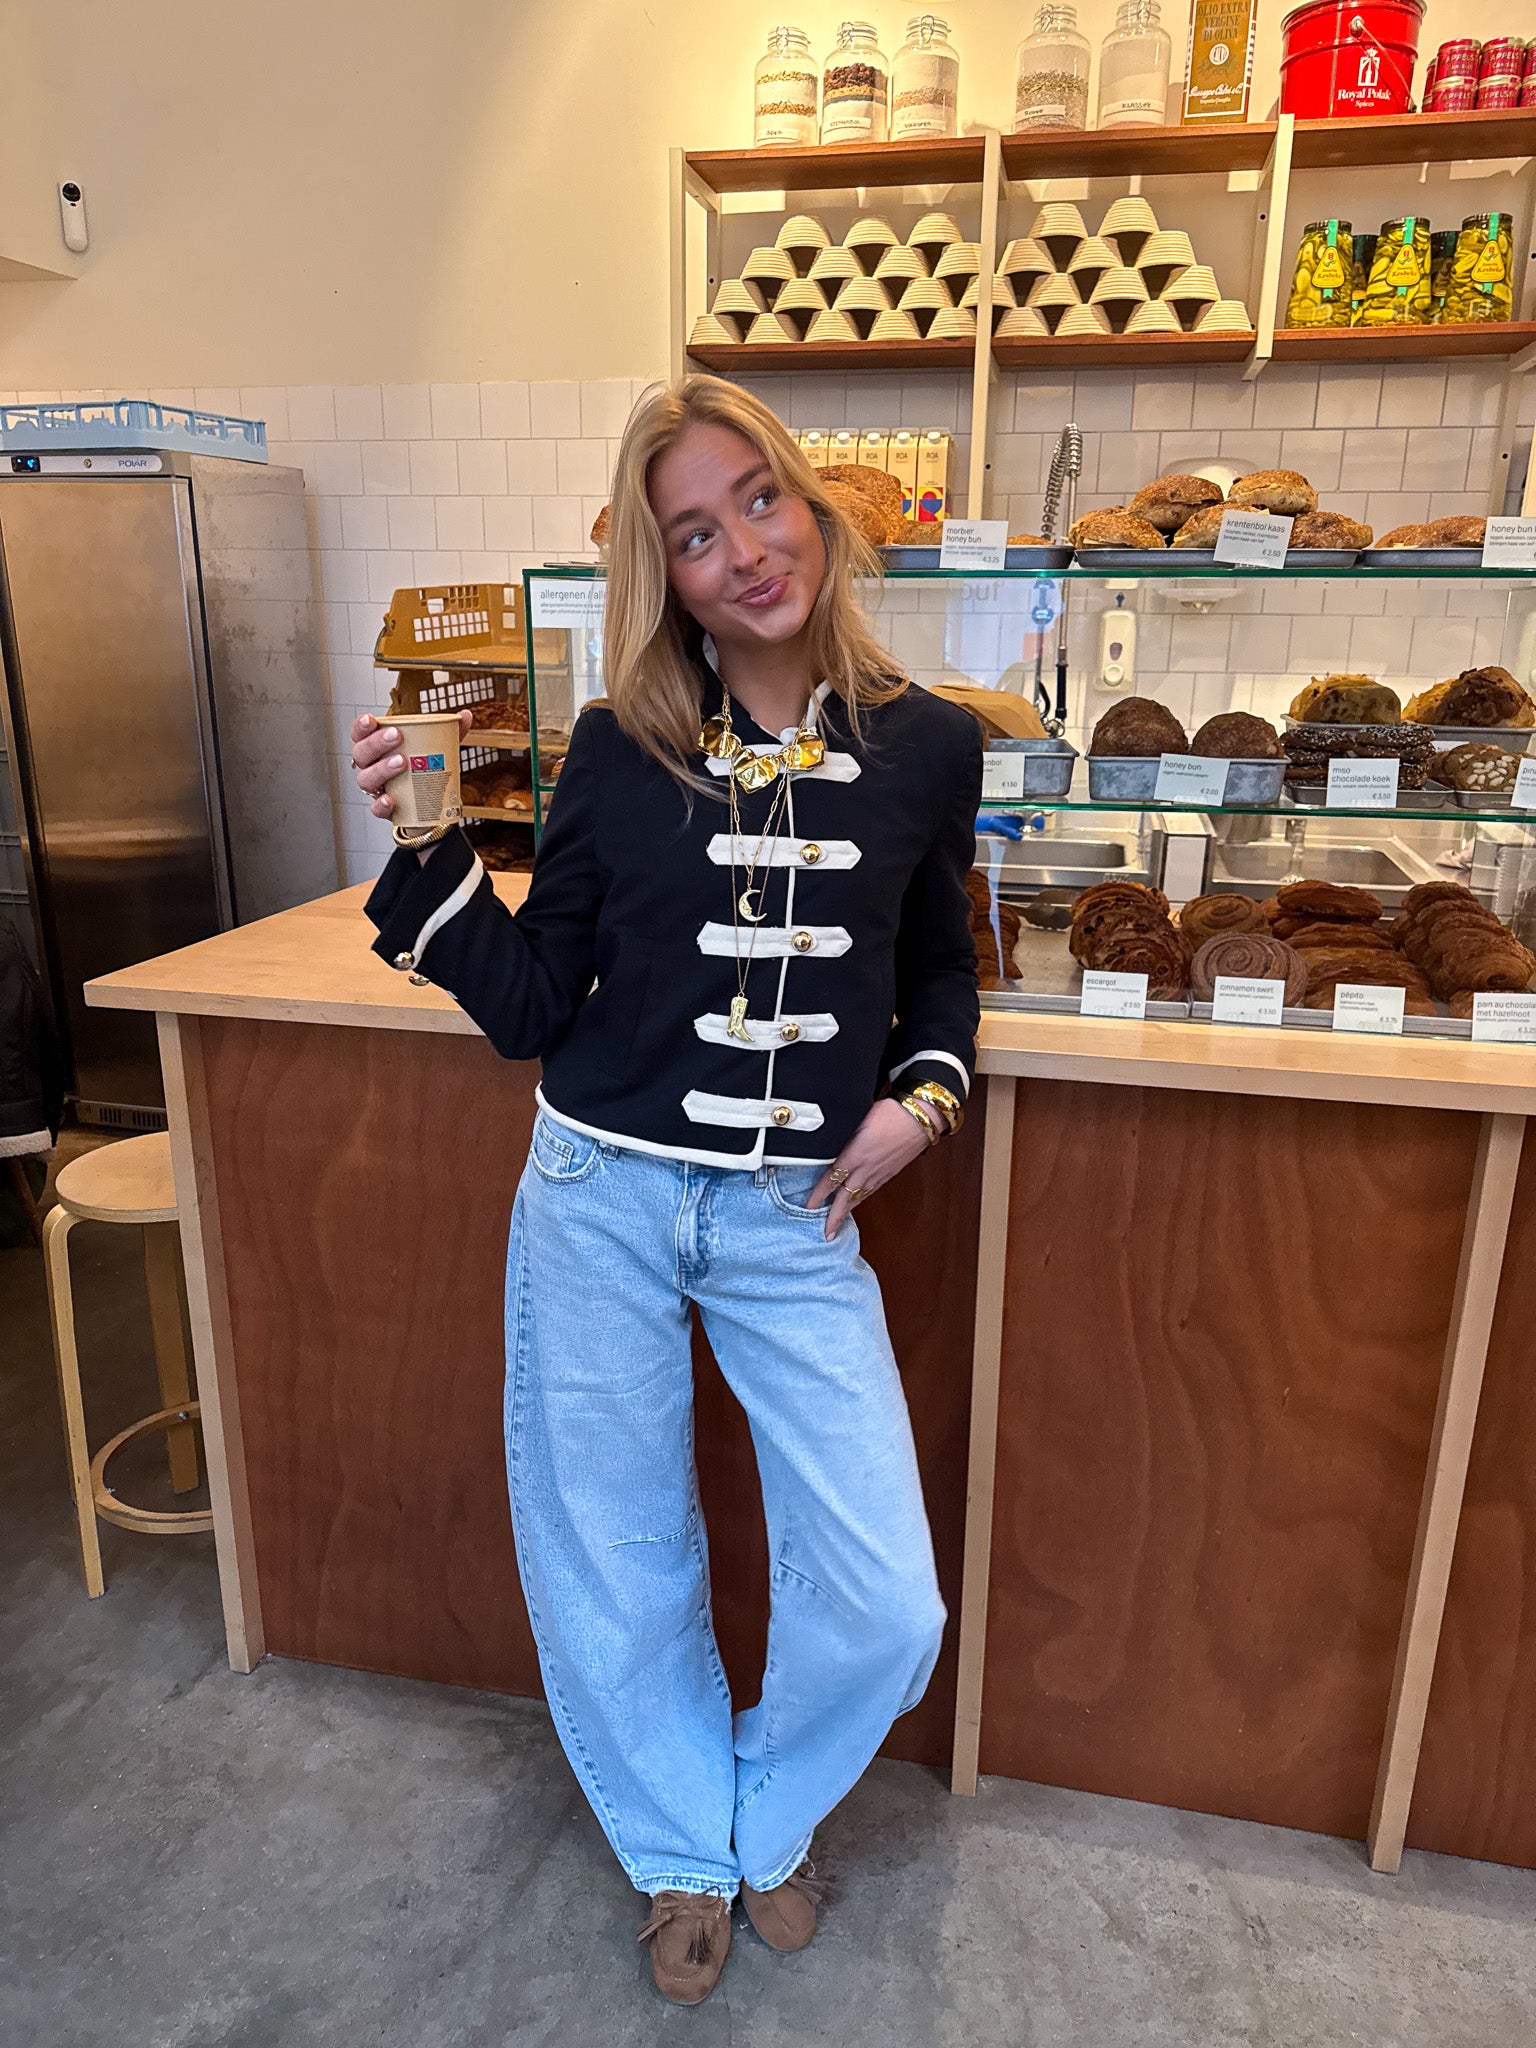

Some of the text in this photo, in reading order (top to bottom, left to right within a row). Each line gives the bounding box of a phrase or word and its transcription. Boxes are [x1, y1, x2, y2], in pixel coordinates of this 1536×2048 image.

[1197, 2, 1248, 16] OLIO EXTRA
[1205, 15, 1240, 28] VERGINE
[1203, 28, 1238, 41] DI OLIVA
[1338, 88, 1391, 101] Royal Polak
[895, 452, 908, 460] ROA
[118, 459, 147, 467] POLAR
[1226, 519, 1286, 533] krentenbol kaas
[1491, 525, 1516, 534] honey
[1517, 525, 1533, 533] bun
[946, 527, 974, 535] morbier
[946, 535, 967, 544] honey
[540, 589, 586, 601] allergenen
[1164, 761, 1202, 771] honey bun
[1331, 774, 1391, 783] chocolade koek
[1086, 978, 1117, 986] escargot
[1219, 984, 1274, 994] cinnamon swirl
[1477, 1001, 1493, 1009] pain
[1505, 1001, 1536, 1009] chocola
[1493, 1010, 1530, 1018] hazelnoot
